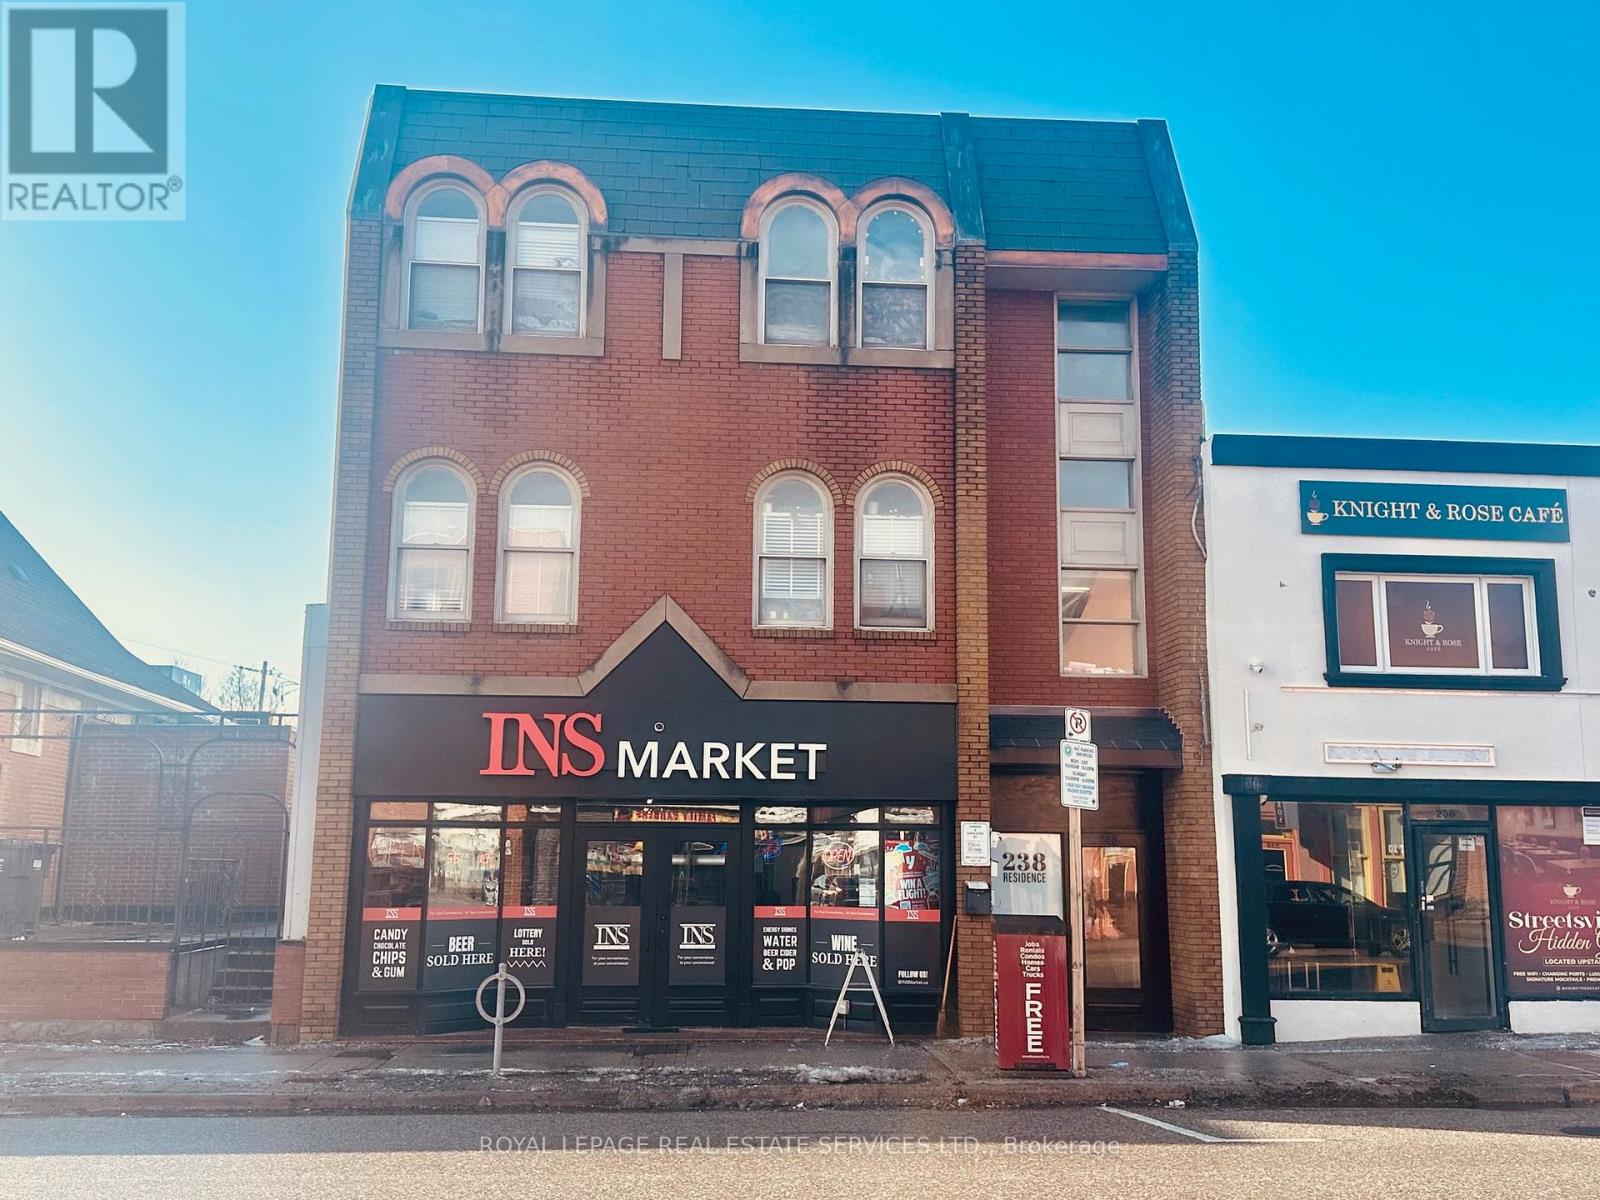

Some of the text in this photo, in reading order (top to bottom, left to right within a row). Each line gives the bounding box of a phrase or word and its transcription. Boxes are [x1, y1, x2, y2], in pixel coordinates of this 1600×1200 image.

[1332, 500, 1564, 524] KNIGHT & ROSE CAFÉ
[1404, 638, 1433, 646] KNIGHT
[1442, 639, 1462, 647] ROSE
[479, 712, 827, 780] INS MARKET
[825, 848, 852, 863] OPEN
[1002, 851, 1046, 872] 238
[900, 878, 916, 889] WIN
[1003, 872, 1047, 883] RESIDENCE
[385, 908, 399, 918] INS
[523, 906, 536, 916] INS
[774, 906, 786, 916] INS
[907, 910, 919, 919] INS
[373, 928, 408, 940] CANDY
[513, 928, 543, 938] LOTTERY
[595, 925, 630, 945] INS
[681, 925, 715, 945] INS
[373, 942, 406, 950] CHOCOLATE
[448, 935, 475, 953] BEER
[762, 935, 798, 947] WATER
[831, 934, 857, 952] WINE
[1518, 927, 1592, 954] Hidden
[372, 951, 406, 965] CHIPS
[509, 947, 546, 957] HERE!
[763, 949, 797, 957] BEER CIDER
[811, 951, 842, 965] SOLD
[426, 952, 494, 967] SOLD HERE
[762, 958, 796, 971] & POP
[371, 966, 405, 978] & GUM
[897, 970, 929, 979] FOLLOW US!
[1025, 982, 1044, 1053] FREE
